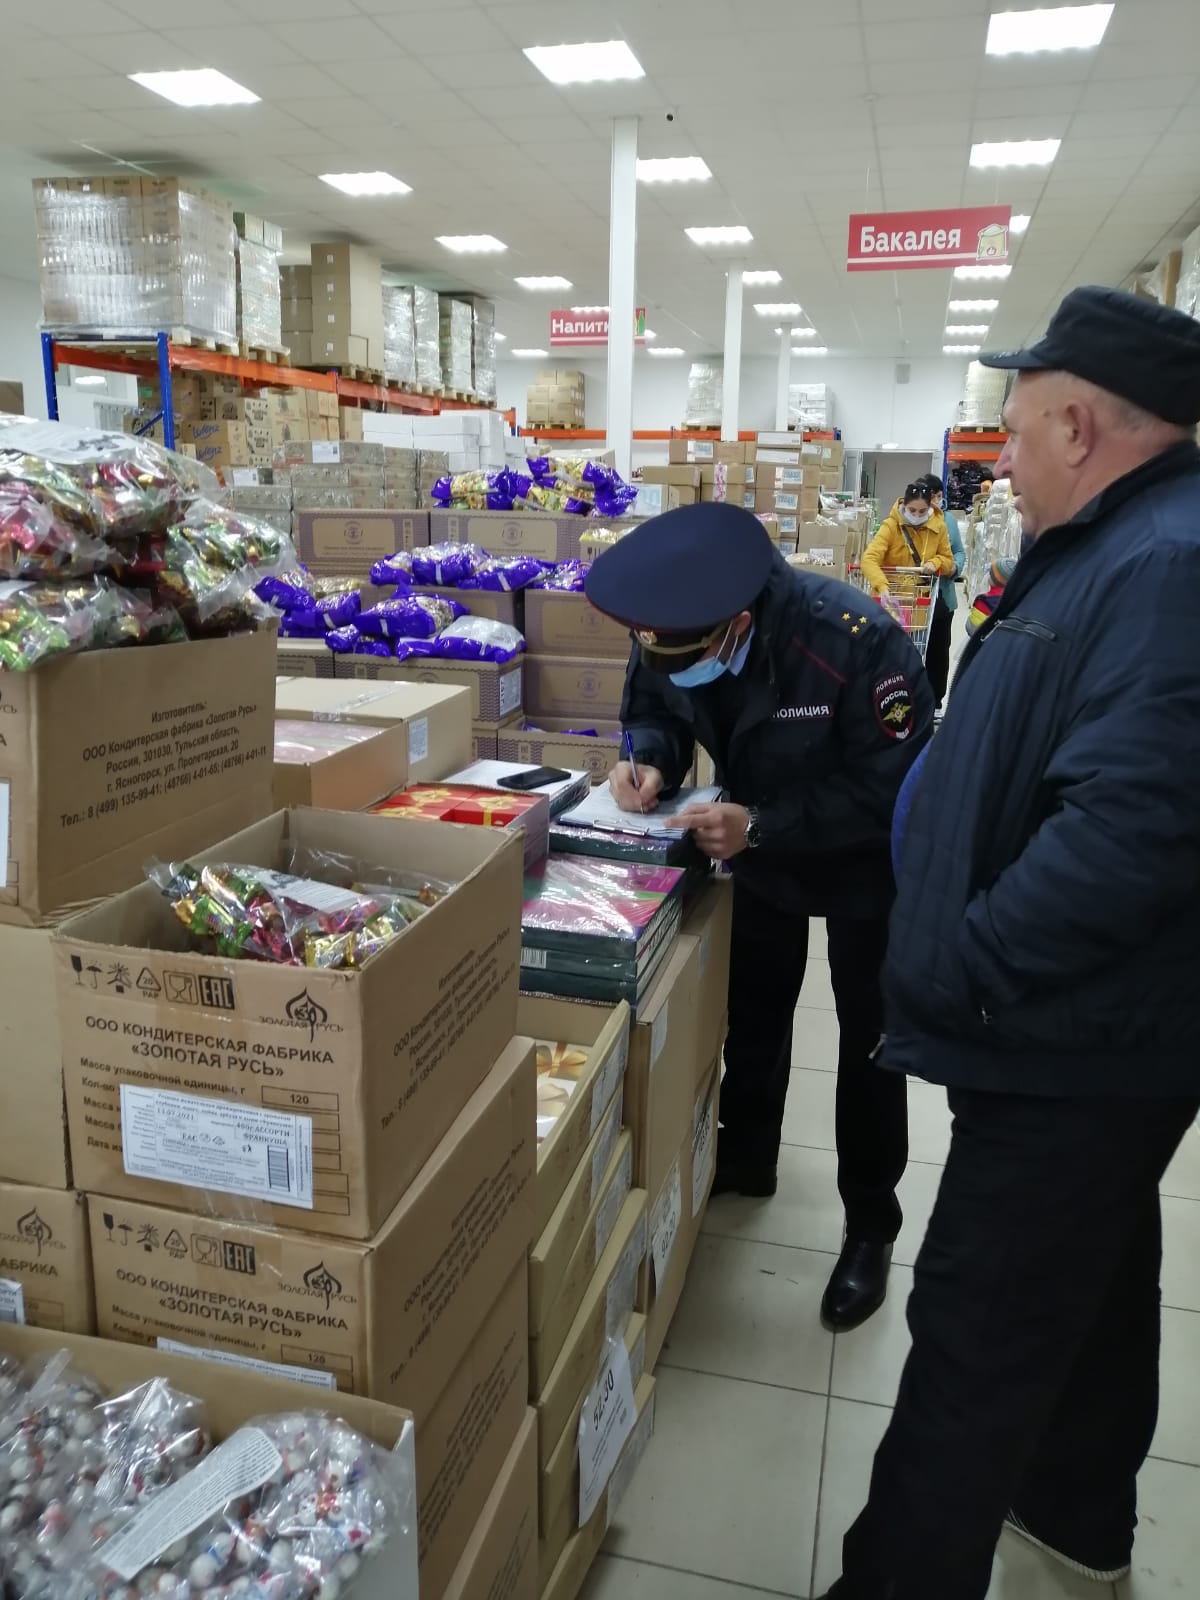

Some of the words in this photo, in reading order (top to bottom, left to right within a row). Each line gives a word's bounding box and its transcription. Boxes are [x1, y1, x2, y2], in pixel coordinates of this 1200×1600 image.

[860, 225, 961, 253] Бакалея
[876, 675, 904, 694] ПОЛИЦИЯ
[880, 689, 908, 709] РОССИЯ
[151, 701, 207, 723] Изготовитель:
[83, 744, 106, 761] ООО
[108, 729, 169, 754] Кондитерская
[171, 719, 204, 738] фабрика
[205, 711, 237, 726] «Золотая
[106, 757, 141, 773] Россия,
[175, 734, 209, 754] Тульская
[211, 725, 240, 742] область,
[115, 768, 162, 791] Ясногорск,
[164, 763, 175, 776] ул.
[230, 739, 239, 751] 20
[61, 811, 85, 828] Тел.:
[88, 806, 94, 818] 8
[96, 798, 118, 818] (499)
[121, 783, 163, 806] 135-99-41;
[259, 1015, 307, 1028] ЗОЛОТАЯ
[316, 1023, 344, 1033] РУСЬ
[86, 1015, 118, 1032] ООО
[123, 1021, 247, 1052] КОНДИТЕРСКАЯ
[252, 1042, 335, 1064] ФАБРИКА
[131, 1041, 222, 1069] «ЗОЛОТАЯ
[227, 1055, 284, 1077] РУСЬ»
[80, 1057, 110, 1071] Масса
[113, 1065, 181, 1086] упаковочной
[183, 1079, 238, 1096] единицы,
[240, 1087, 246, 1096] г
[82, 1077, 114, 1091] Кол-во
[83, 1096, 114, 1111] Масса
[290, 1093, 309, 1106] 120
[85, 1115, 115, 1131] Масса
[87, 1136, 110, 1149] Дата
[0, 1257, 59, 1277] АБРИКА
[116, 1268, 147, 1287] ООО
[150, 1278, 268, 1316] КОНДИТЕРСКАЯ
[272, 1305, 349, 1331] ФАБРИКА
[112, 1304, 140, 1321] Масса
[159, 1297, 244, 1326] «ЗОЛОТАЯ
[248, 1315, 303, 1339] РУСЬ»
[307, 1352, 326, 1365] 120
[593, 1368, 615, 1432] 52.30
